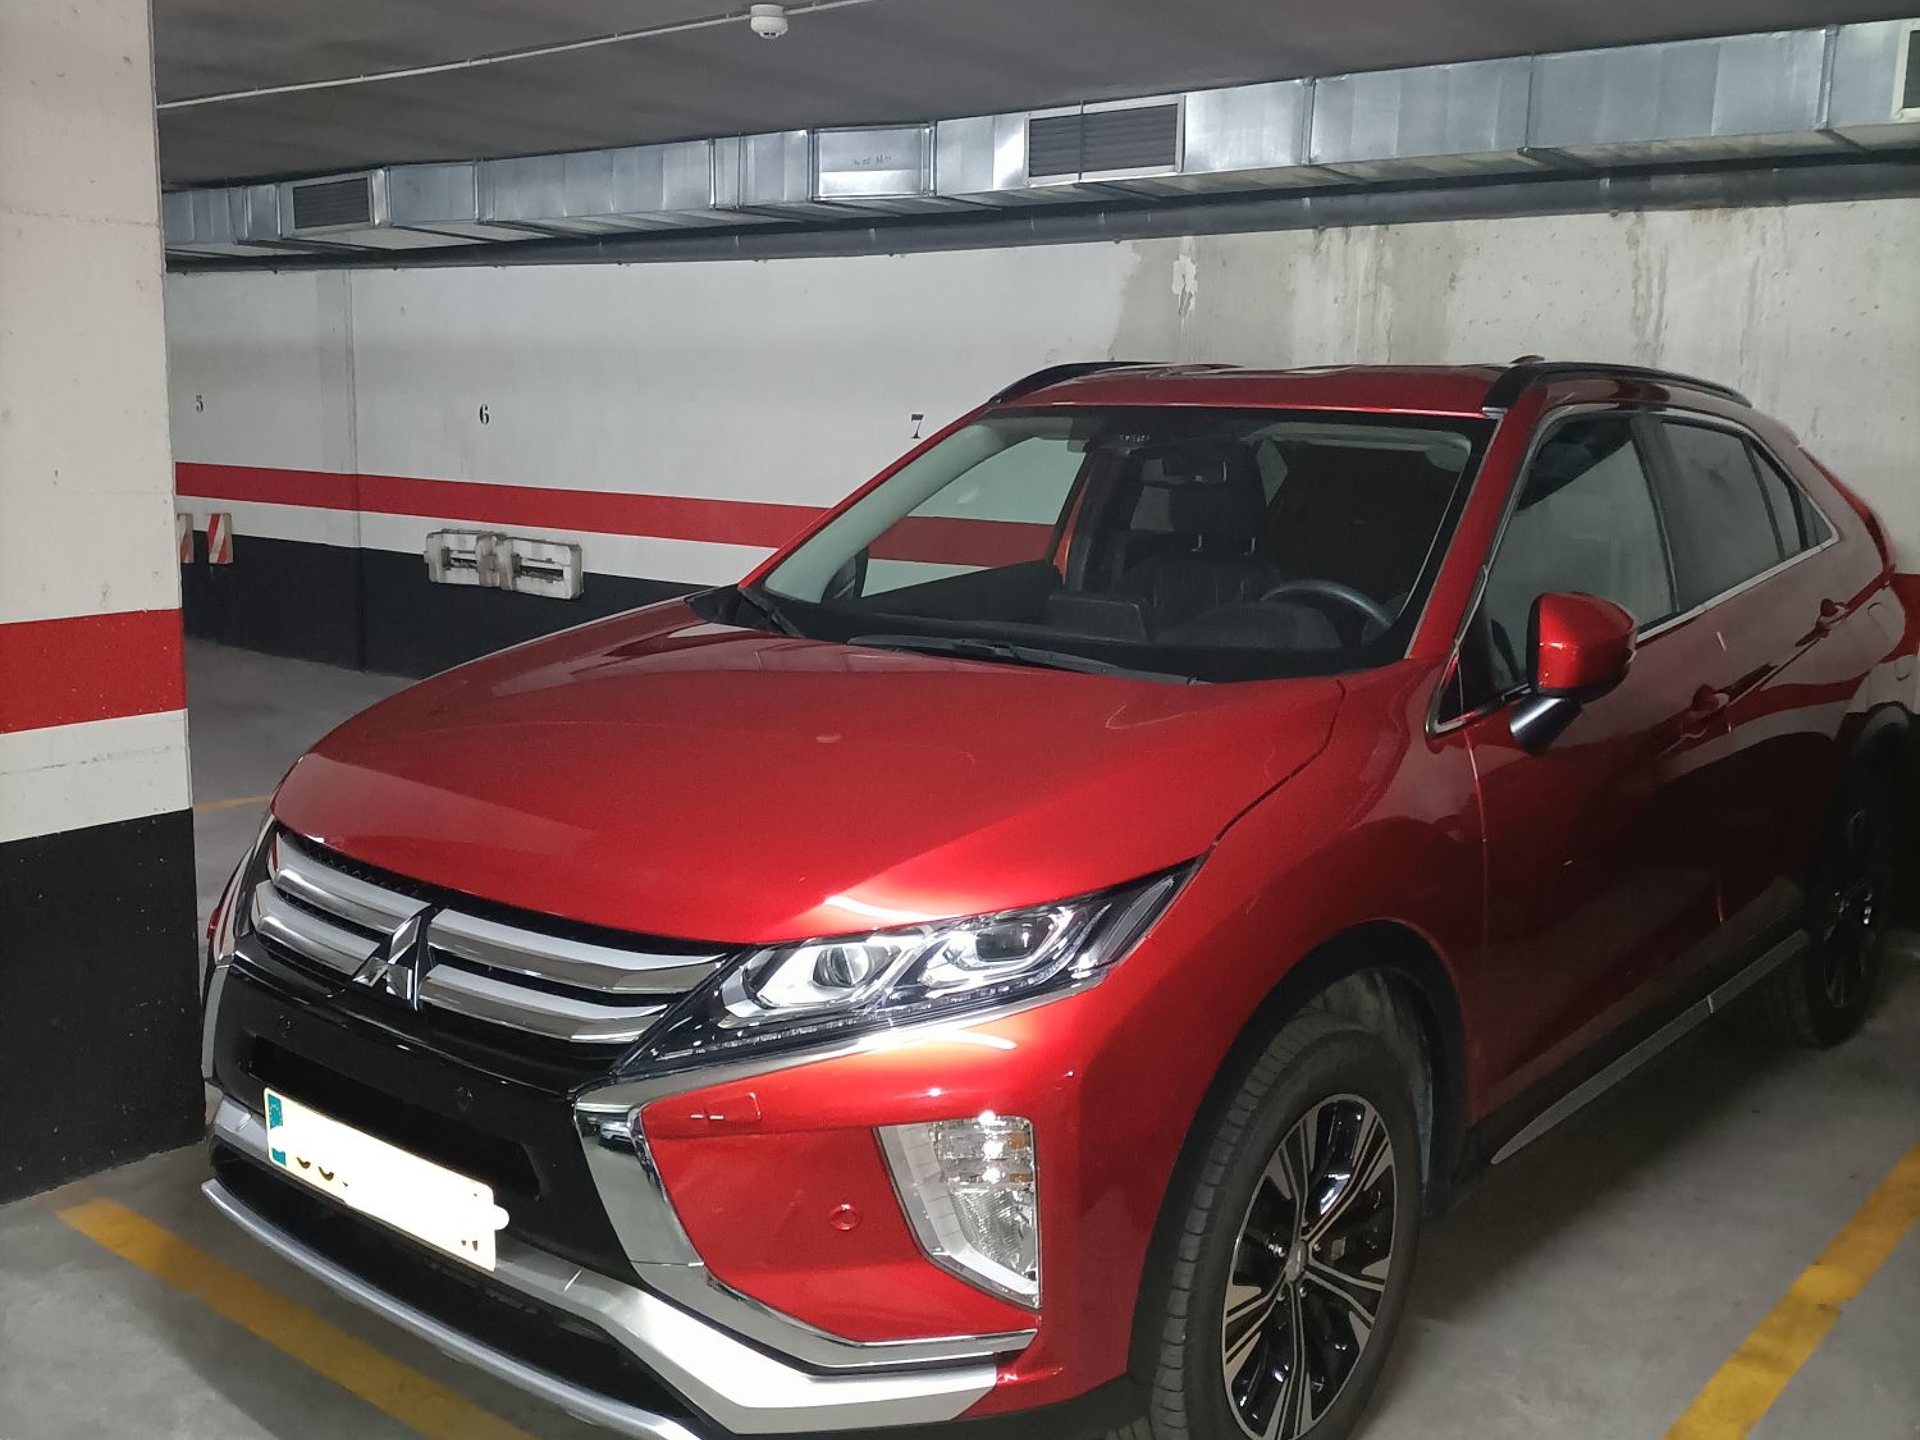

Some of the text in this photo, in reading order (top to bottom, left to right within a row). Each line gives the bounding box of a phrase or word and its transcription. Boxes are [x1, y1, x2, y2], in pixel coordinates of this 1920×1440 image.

[195, 394, 204, 413] 5
[479, 404, 490, 425] 6
[911, 414, 924, 439] 7
